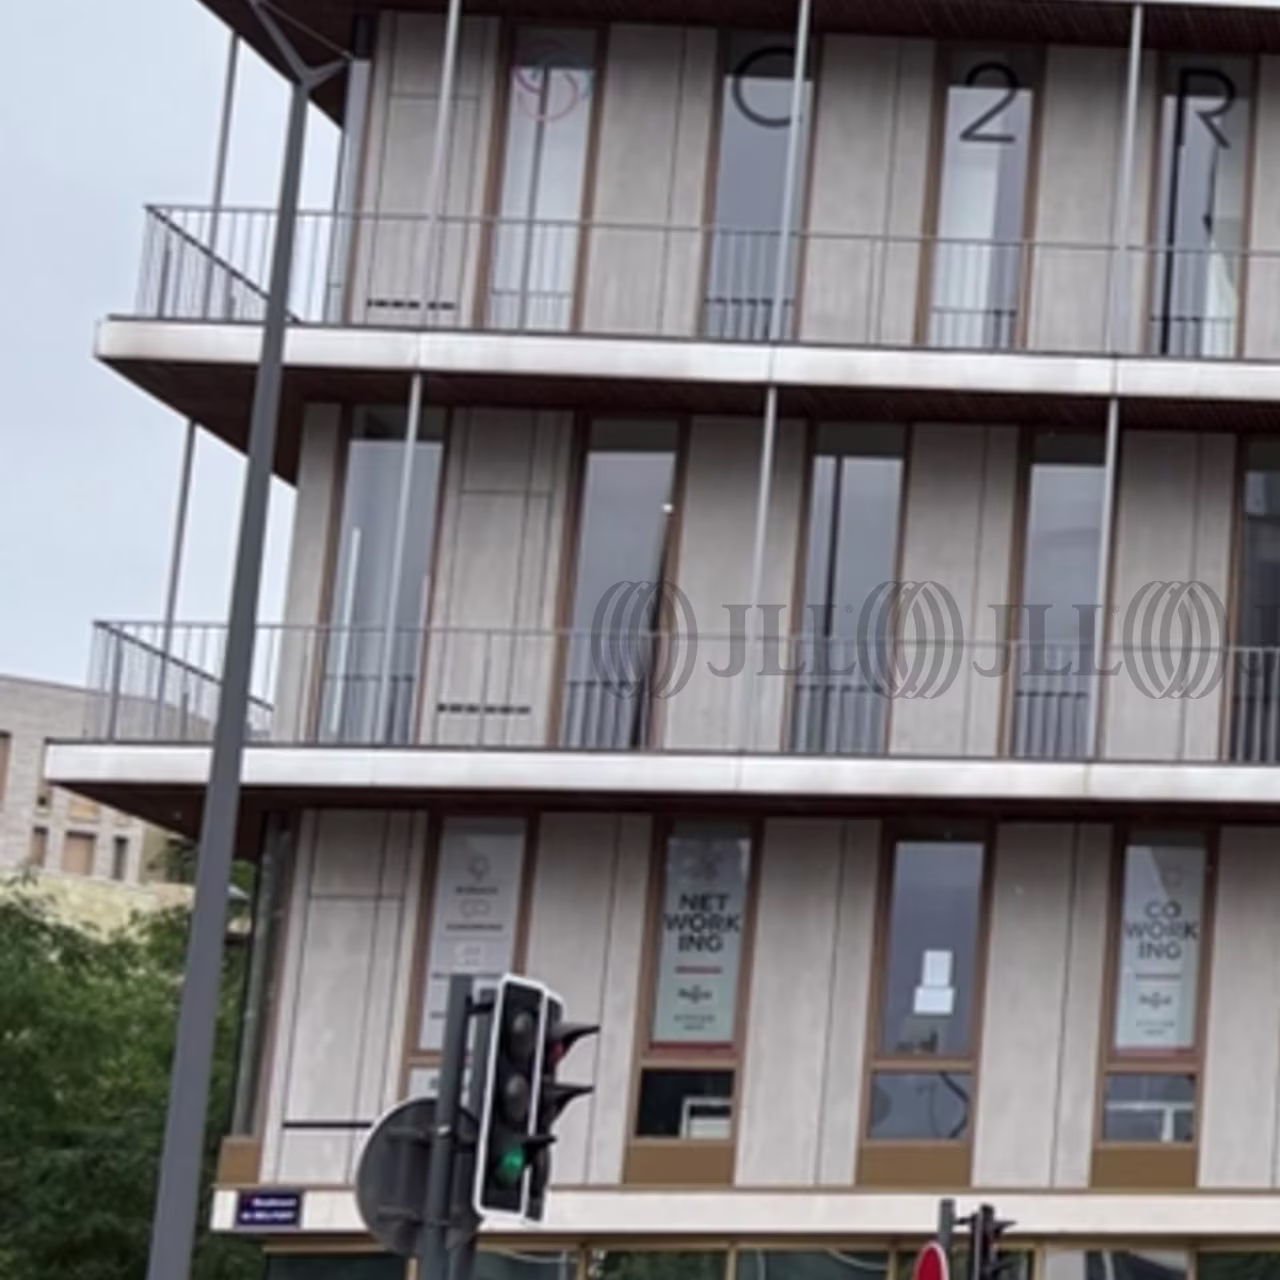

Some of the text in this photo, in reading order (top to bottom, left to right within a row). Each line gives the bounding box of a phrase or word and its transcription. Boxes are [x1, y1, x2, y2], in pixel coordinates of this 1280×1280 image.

[678, 893, 730, 911] NET
[1144, 899, 1182, 919] CO
[664, 912, 740, 932] WORK
[1125, 920, 1199, 941] WORK
[677, 933, 723, 953] ING
[1137, 940, 1182, 960] ING
